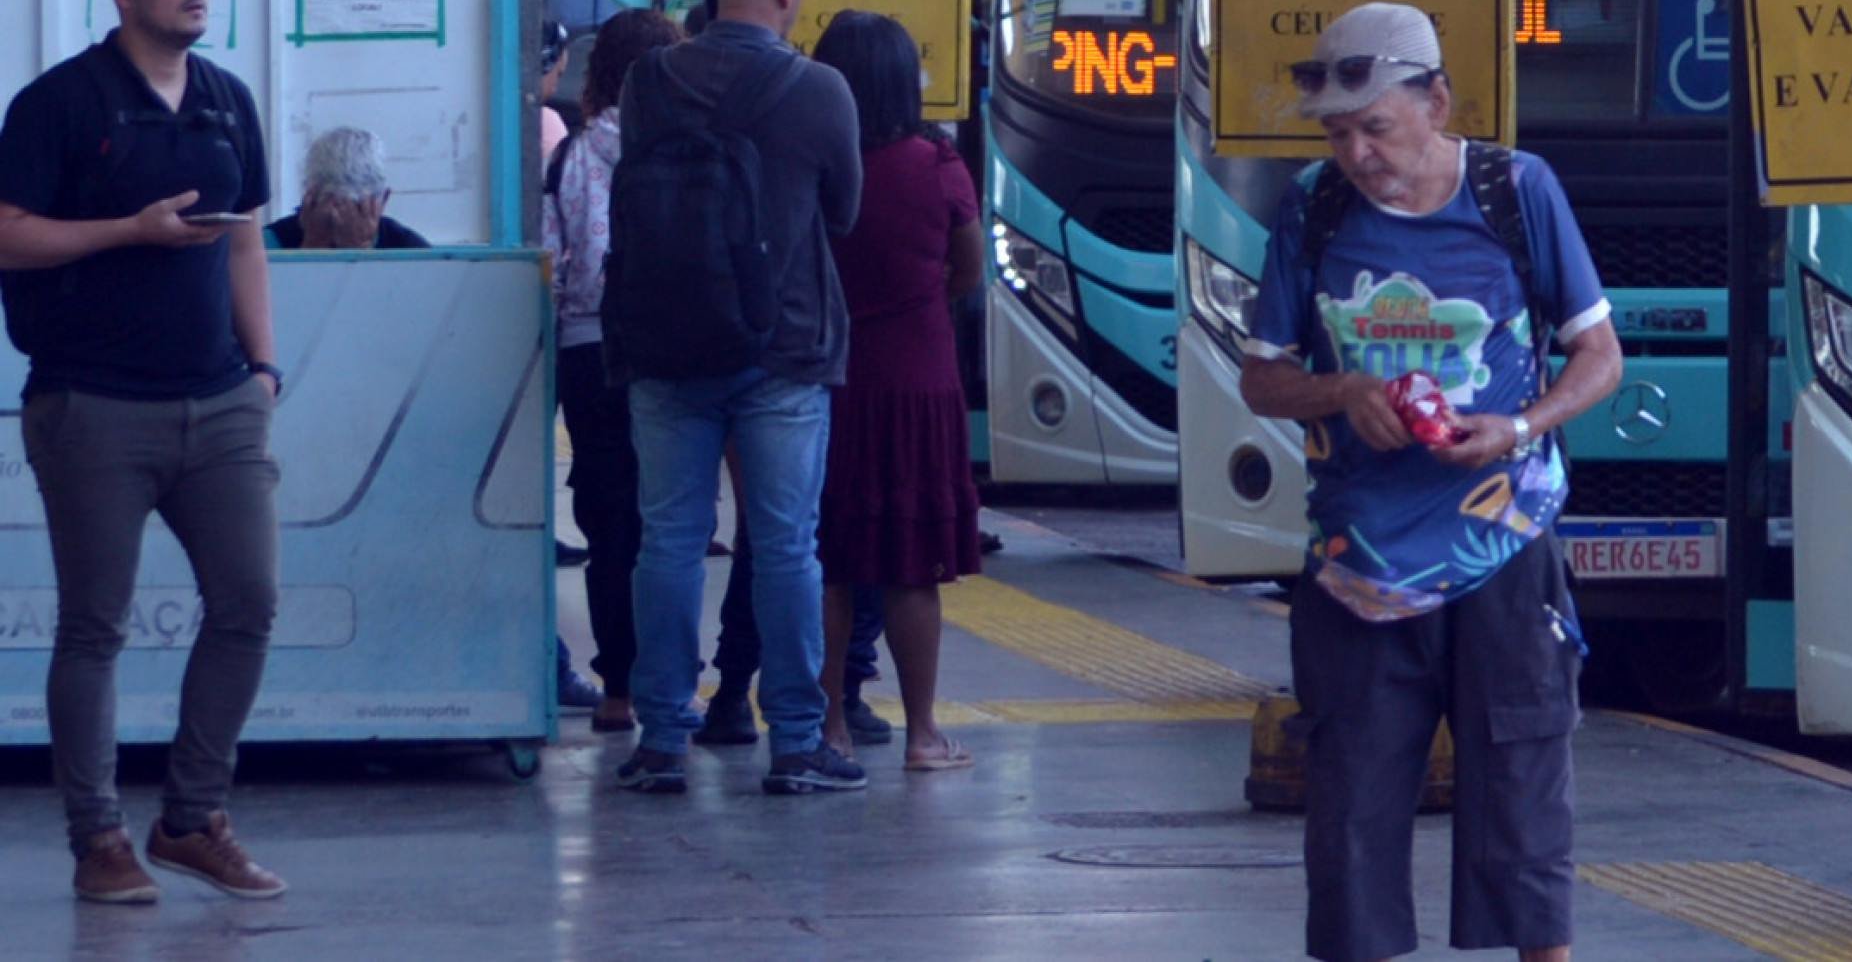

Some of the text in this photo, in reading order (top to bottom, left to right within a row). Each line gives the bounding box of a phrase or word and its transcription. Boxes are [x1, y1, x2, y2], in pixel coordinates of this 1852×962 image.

[1775, 74, 1799, 107] E
[1353, 316, 1456, 339] Tennis
[1572, 540, 1701, 572] RER6E45
